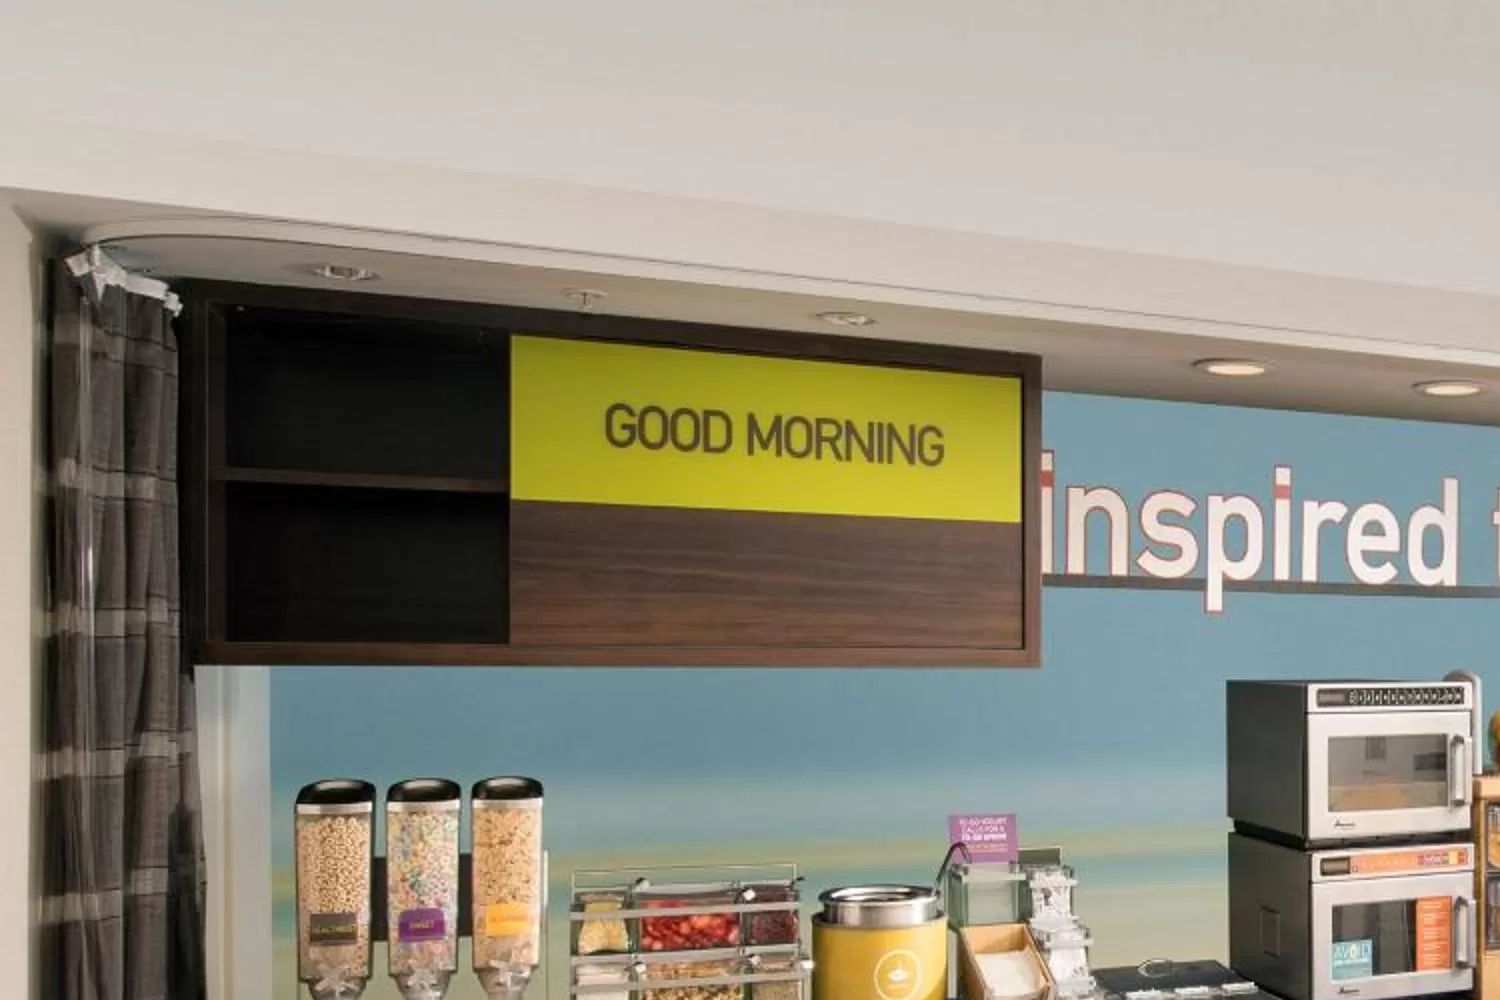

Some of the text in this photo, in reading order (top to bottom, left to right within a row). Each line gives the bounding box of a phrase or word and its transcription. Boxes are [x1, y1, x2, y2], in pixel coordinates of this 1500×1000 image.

[605, 402, 945, 466] GOOD MORNING
[1041, 450, 1459, 614] inspired
